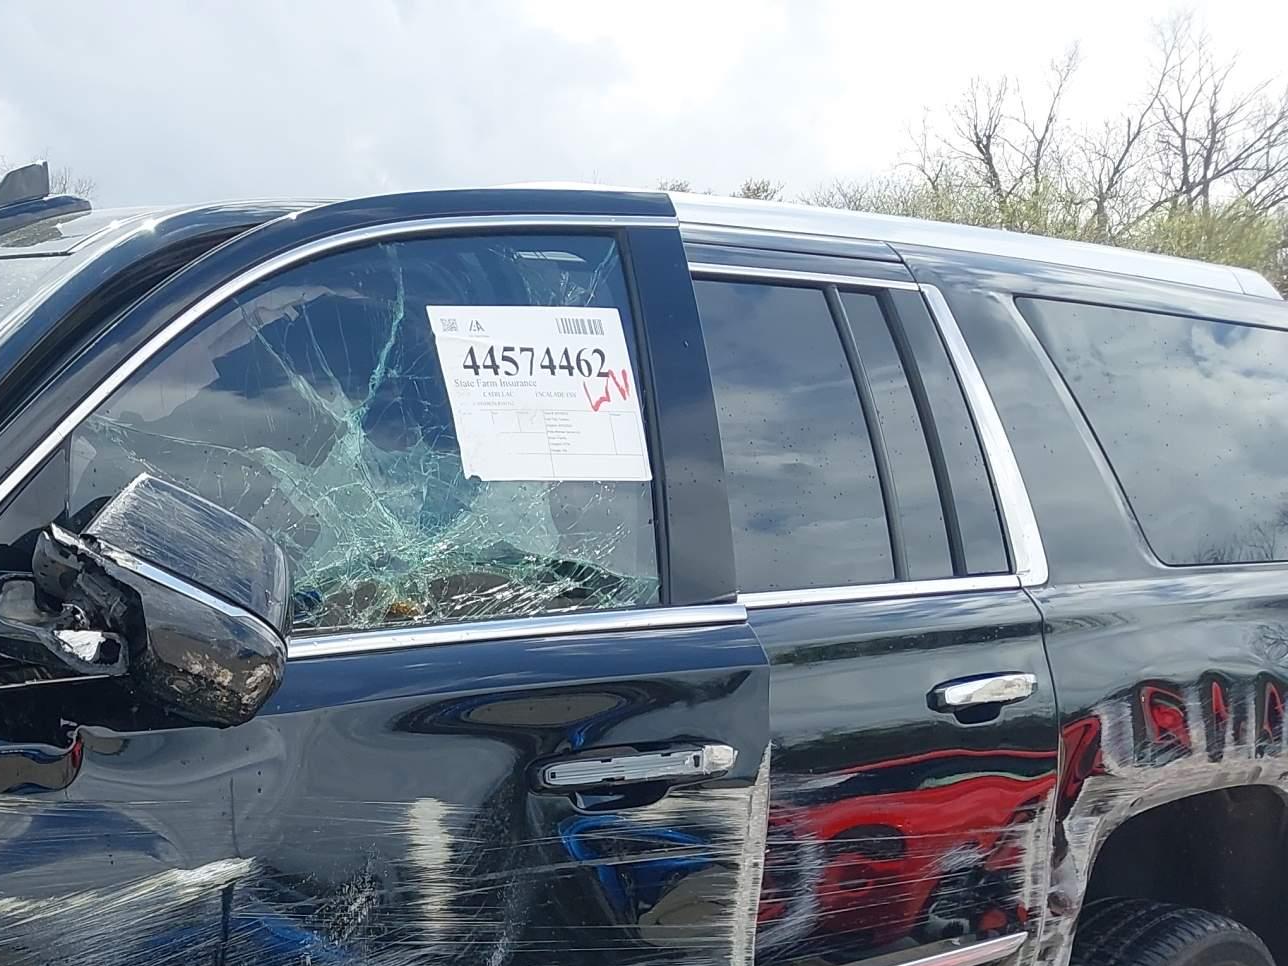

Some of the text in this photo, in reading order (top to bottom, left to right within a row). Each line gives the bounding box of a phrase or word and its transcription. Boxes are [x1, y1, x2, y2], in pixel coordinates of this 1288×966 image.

[463, 345, 608, 378] 44574462
[454, 378, 537, 388] State Farm Insurance
